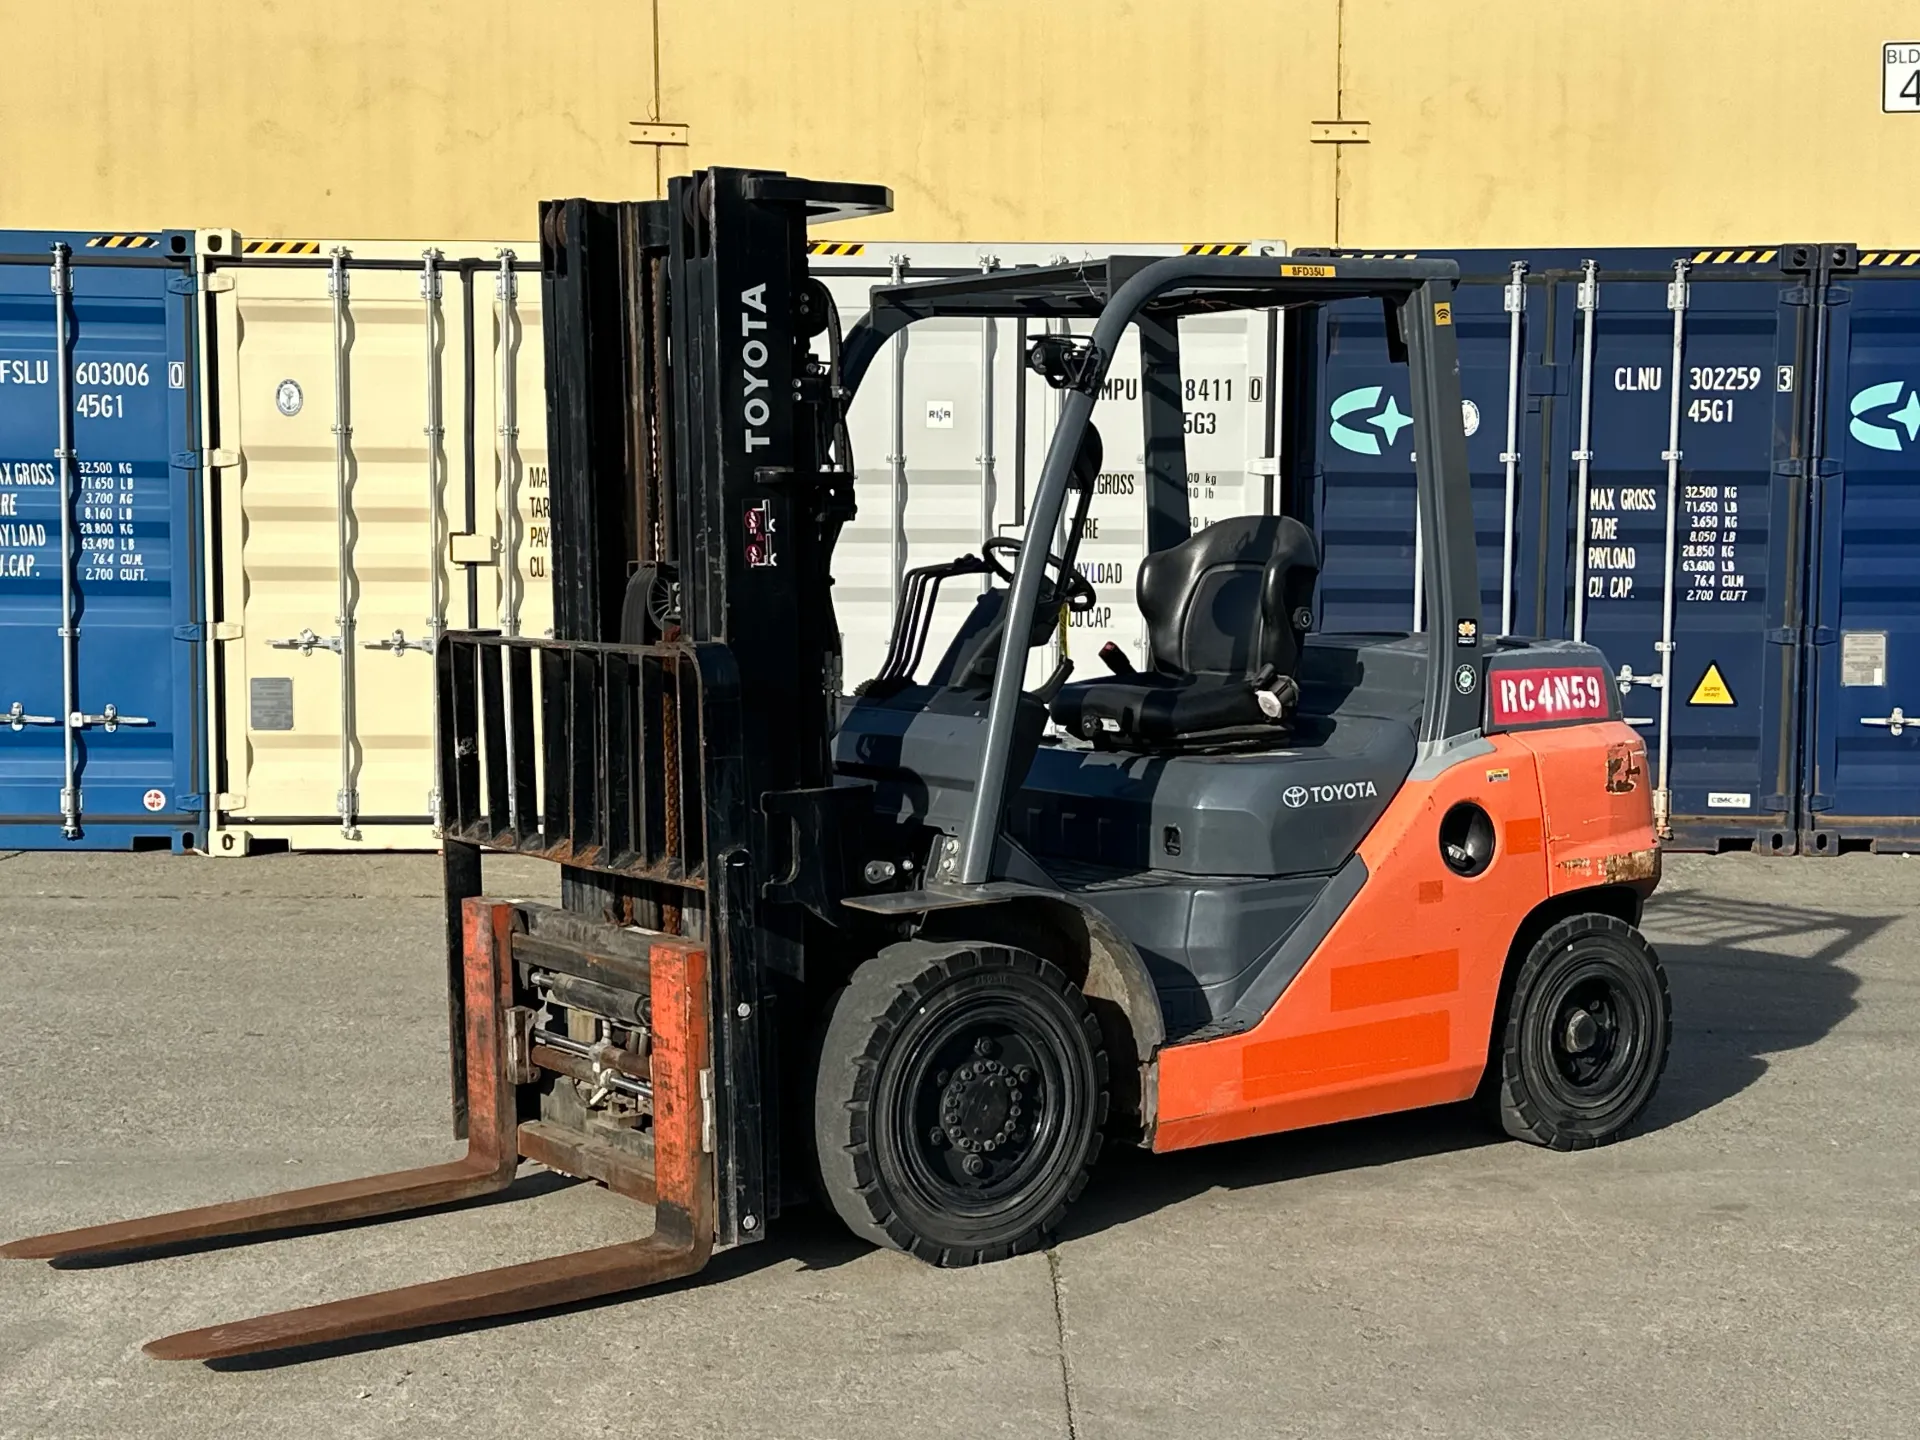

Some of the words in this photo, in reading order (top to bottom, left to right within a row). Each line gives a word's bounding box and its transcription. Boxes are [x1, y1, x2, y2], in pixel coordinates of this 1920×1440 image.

[1887, 49, 1920, 64] BLD
[1292, 266, 1325, 277] 8FD35U
[0, 360, 48, 384] FSLU
[75, 362, 149, 386] 603006
[171, 364, 183, 387] 0
[741, 282, 770, 453] TOYOTA
[1614, 367, 1662, 391] CLNU
[1689, 367, 1761, 391] 302259
[1779, 368, 1791, 391] 3
[1100, 378, 1137, 401] MPU
[1185, 378, 1232, 401] 8411
[1251, 378, 1261, 401] 0
[76, 394, 123, 418] 45G1
[1688, 399, 1733, 423] 45G1
[1183, 412, 1216, 435] 5G3
[14, 463, 55, 486] GROSS
[79, 461, 112, 474] 32.500
[119, 462, 133, 475] KG
[529, 466, 549, 488] MA
[81, 476, 114, 490] 71.650
[120, 478, 134, 490] LB
[1188, 472, 1200, 484] 00
[1205, 472, 1217, 486] kg
[85, 492, 113, 504] 3.700
[119, 493, 133, 505] KG
[1590, 488, 1616, 511] MAX
[1620, 488, 1657, 511] GROSS
[1685, 486, 1718, 499] 32.500
[1723, 487, 1738, 499] KG
[1, 493, 18, 516] RE
[529, 496, 551, 518] TAR
[1685, 501, 1718, 513] 71.650
[1724, 502, 1738, 513] LB
[84, 507, 113, 520] 8.160
[119, 507, 133, 521] LB
[1691, 516, 1718, 528] 3.650
[1724, 516, 1738, 528] KG
[0, 524, 46, 547] YLOAD
[119, 523, 134, 535] KG
[530, 526, 550, 548] PAY
[1590, 517, 1619, 540] TARE
[1722, 532, 1737, 543] LB
[82, 537, 115, 550] 63.490
[121, 538, 135, 551] LB
[1721, 546, 1735, 558] KG
[92, 553, 114, 565] 76.4
[1588, 547, 1636, 570] PAYLOAD
[1721, 561, 1735, 572] LB
[85, 567, 114, 581] 2.700
[1694, 575, 1716, 588] 76.4
[1588, 577, 1605, 599] CU.
[1610, 577, 1635, 599] CAP.
[1686, 590, 1714, 602] 2.700
[1501, 675, 1600, 713] RC4N59
[1310, 781, 1377, 802] TOYOTA
